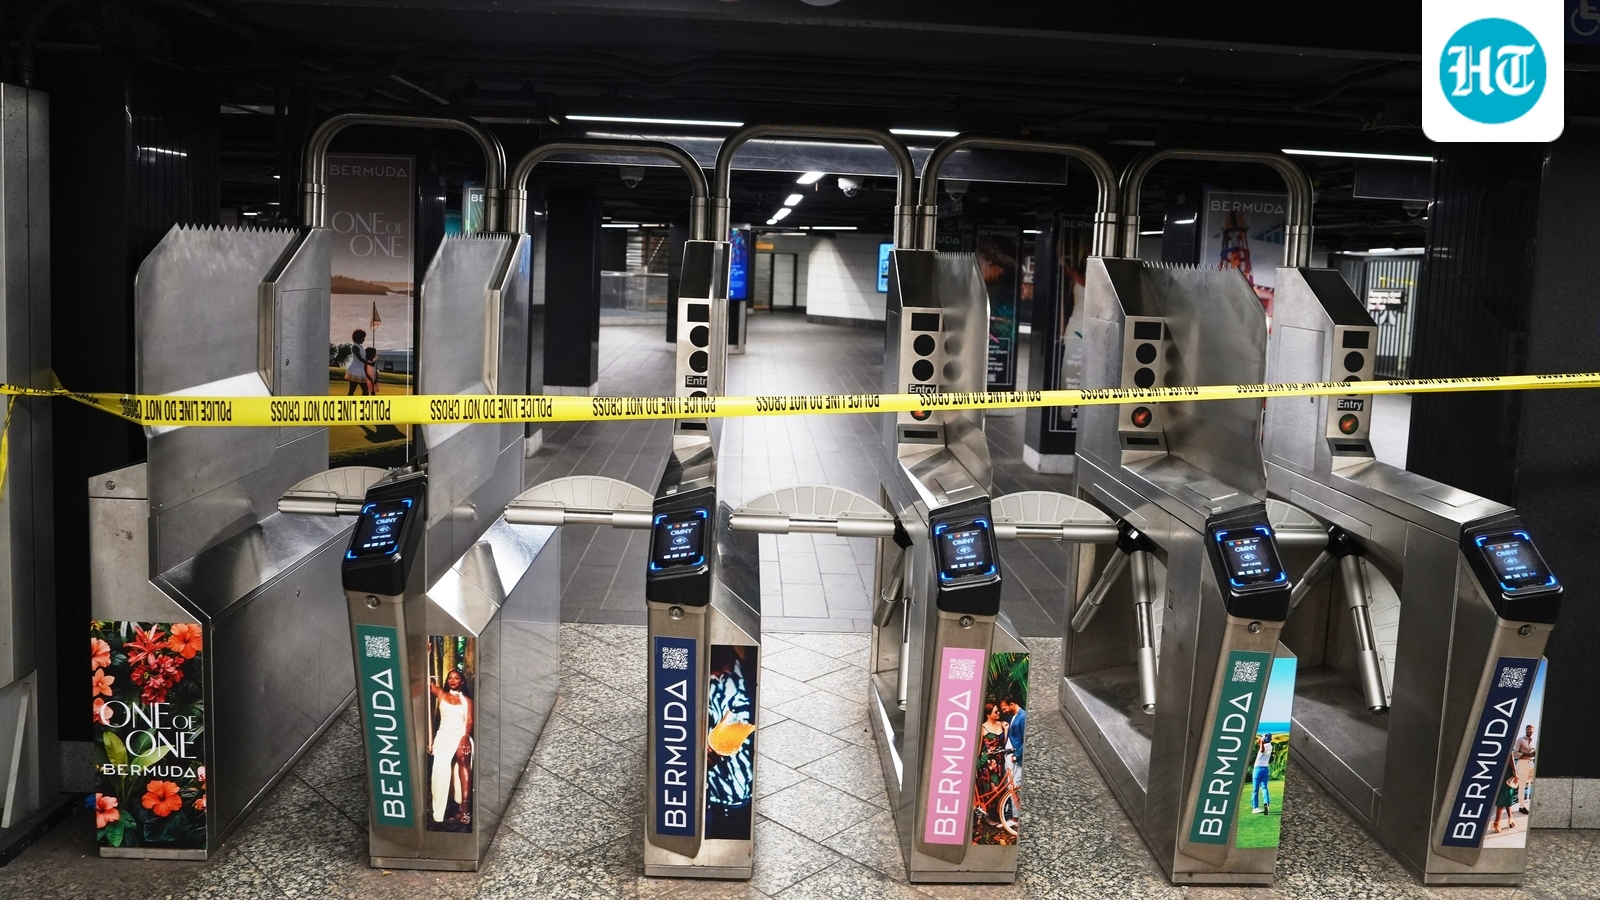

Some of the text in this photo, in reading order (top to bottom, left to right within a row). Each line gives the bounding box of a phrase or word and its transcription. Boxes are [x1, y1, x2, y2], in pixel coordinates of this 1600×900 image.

[329, 164, 407, 178] BERMUDA
[1210, 200, 1285, 214] BERMUDA
[331, 211, 385, 234] ONE
[349, 234, 404, 258] ONE
[686, 375, 707, 386] Entr
[908, 384, 936, 394] Entry
[145, 400, 162, 420] NOT
[164, 400, 176, 420] DO
[179, 400, 198, 421] LINE
[201, 400, 232, 421] POLICE
[271, 400, 391, 421] POLICE LINE DO NOT CROSS
[430, 398, 552, 420] POLICE LINE DO NOT CROSS
[592, 396, 716, 416] POLICE LINE DO NOT CROSS
[1337, 399, 1363, 410] Entry
[670, 528, 693, 536] OMNY
[952, 537, 975, 546] OMNY
[1234, 544, 1257, 553] OMNY
[100, 700, 197, 730] ONE OF
[125, 730, 197, 759] ONE
[370, 667, 406, 820] BERMUDA
[664, 679, 688, 829] BERMUDA
[103, 763, 196, 778] BERMUDA
[934, 689, 972, 836] BERMUDA
[1198, 691, 1254, 838] BERMUDA
[1452, 696, 1519, 841] BERMUDA
